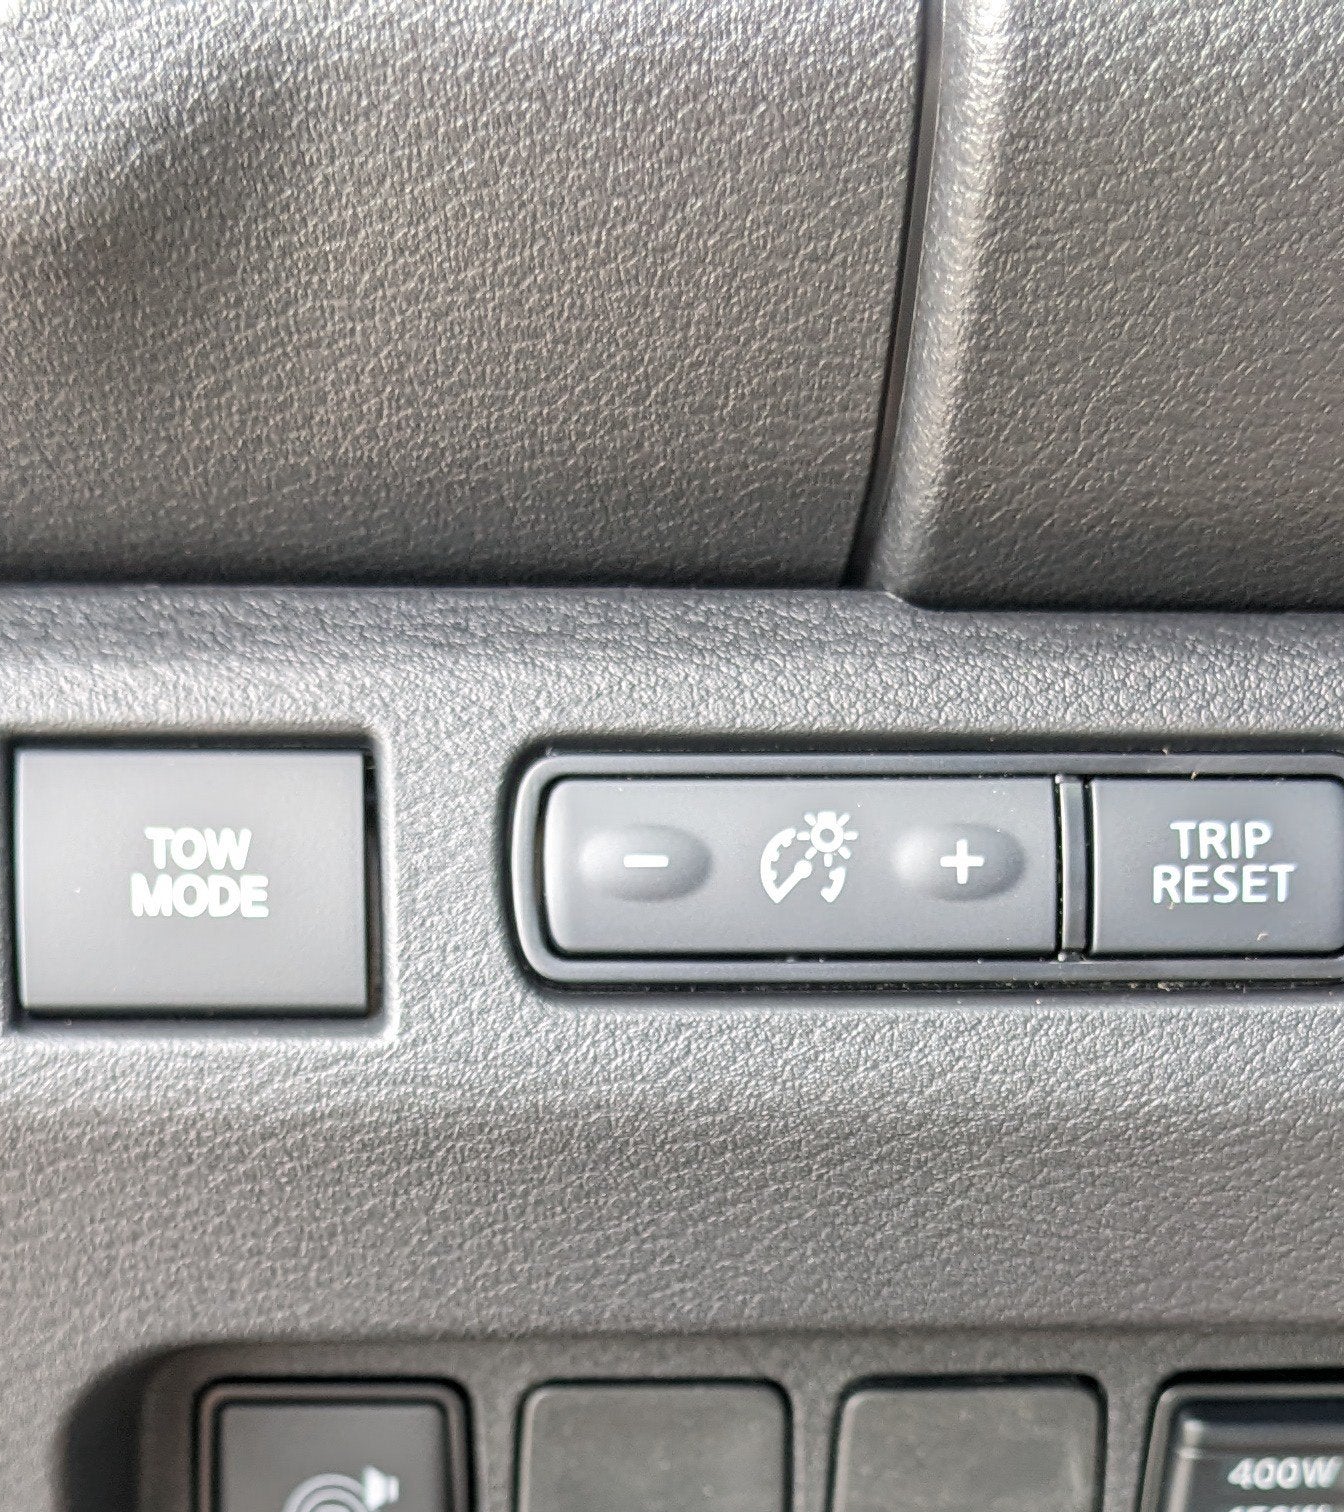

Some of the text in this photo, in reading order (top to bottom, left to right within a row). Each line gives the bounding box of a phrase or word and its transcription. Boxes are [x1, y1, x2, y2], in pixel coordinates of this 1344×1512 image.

[144, 826, 253, 871] TOW
[1169, 820, 1273, 860] TRIP
[130, 871, 270, 918] MODE
[1153, 863, 1298, 904] RESET
[1227, 1456, 1343, 1490] 400W
